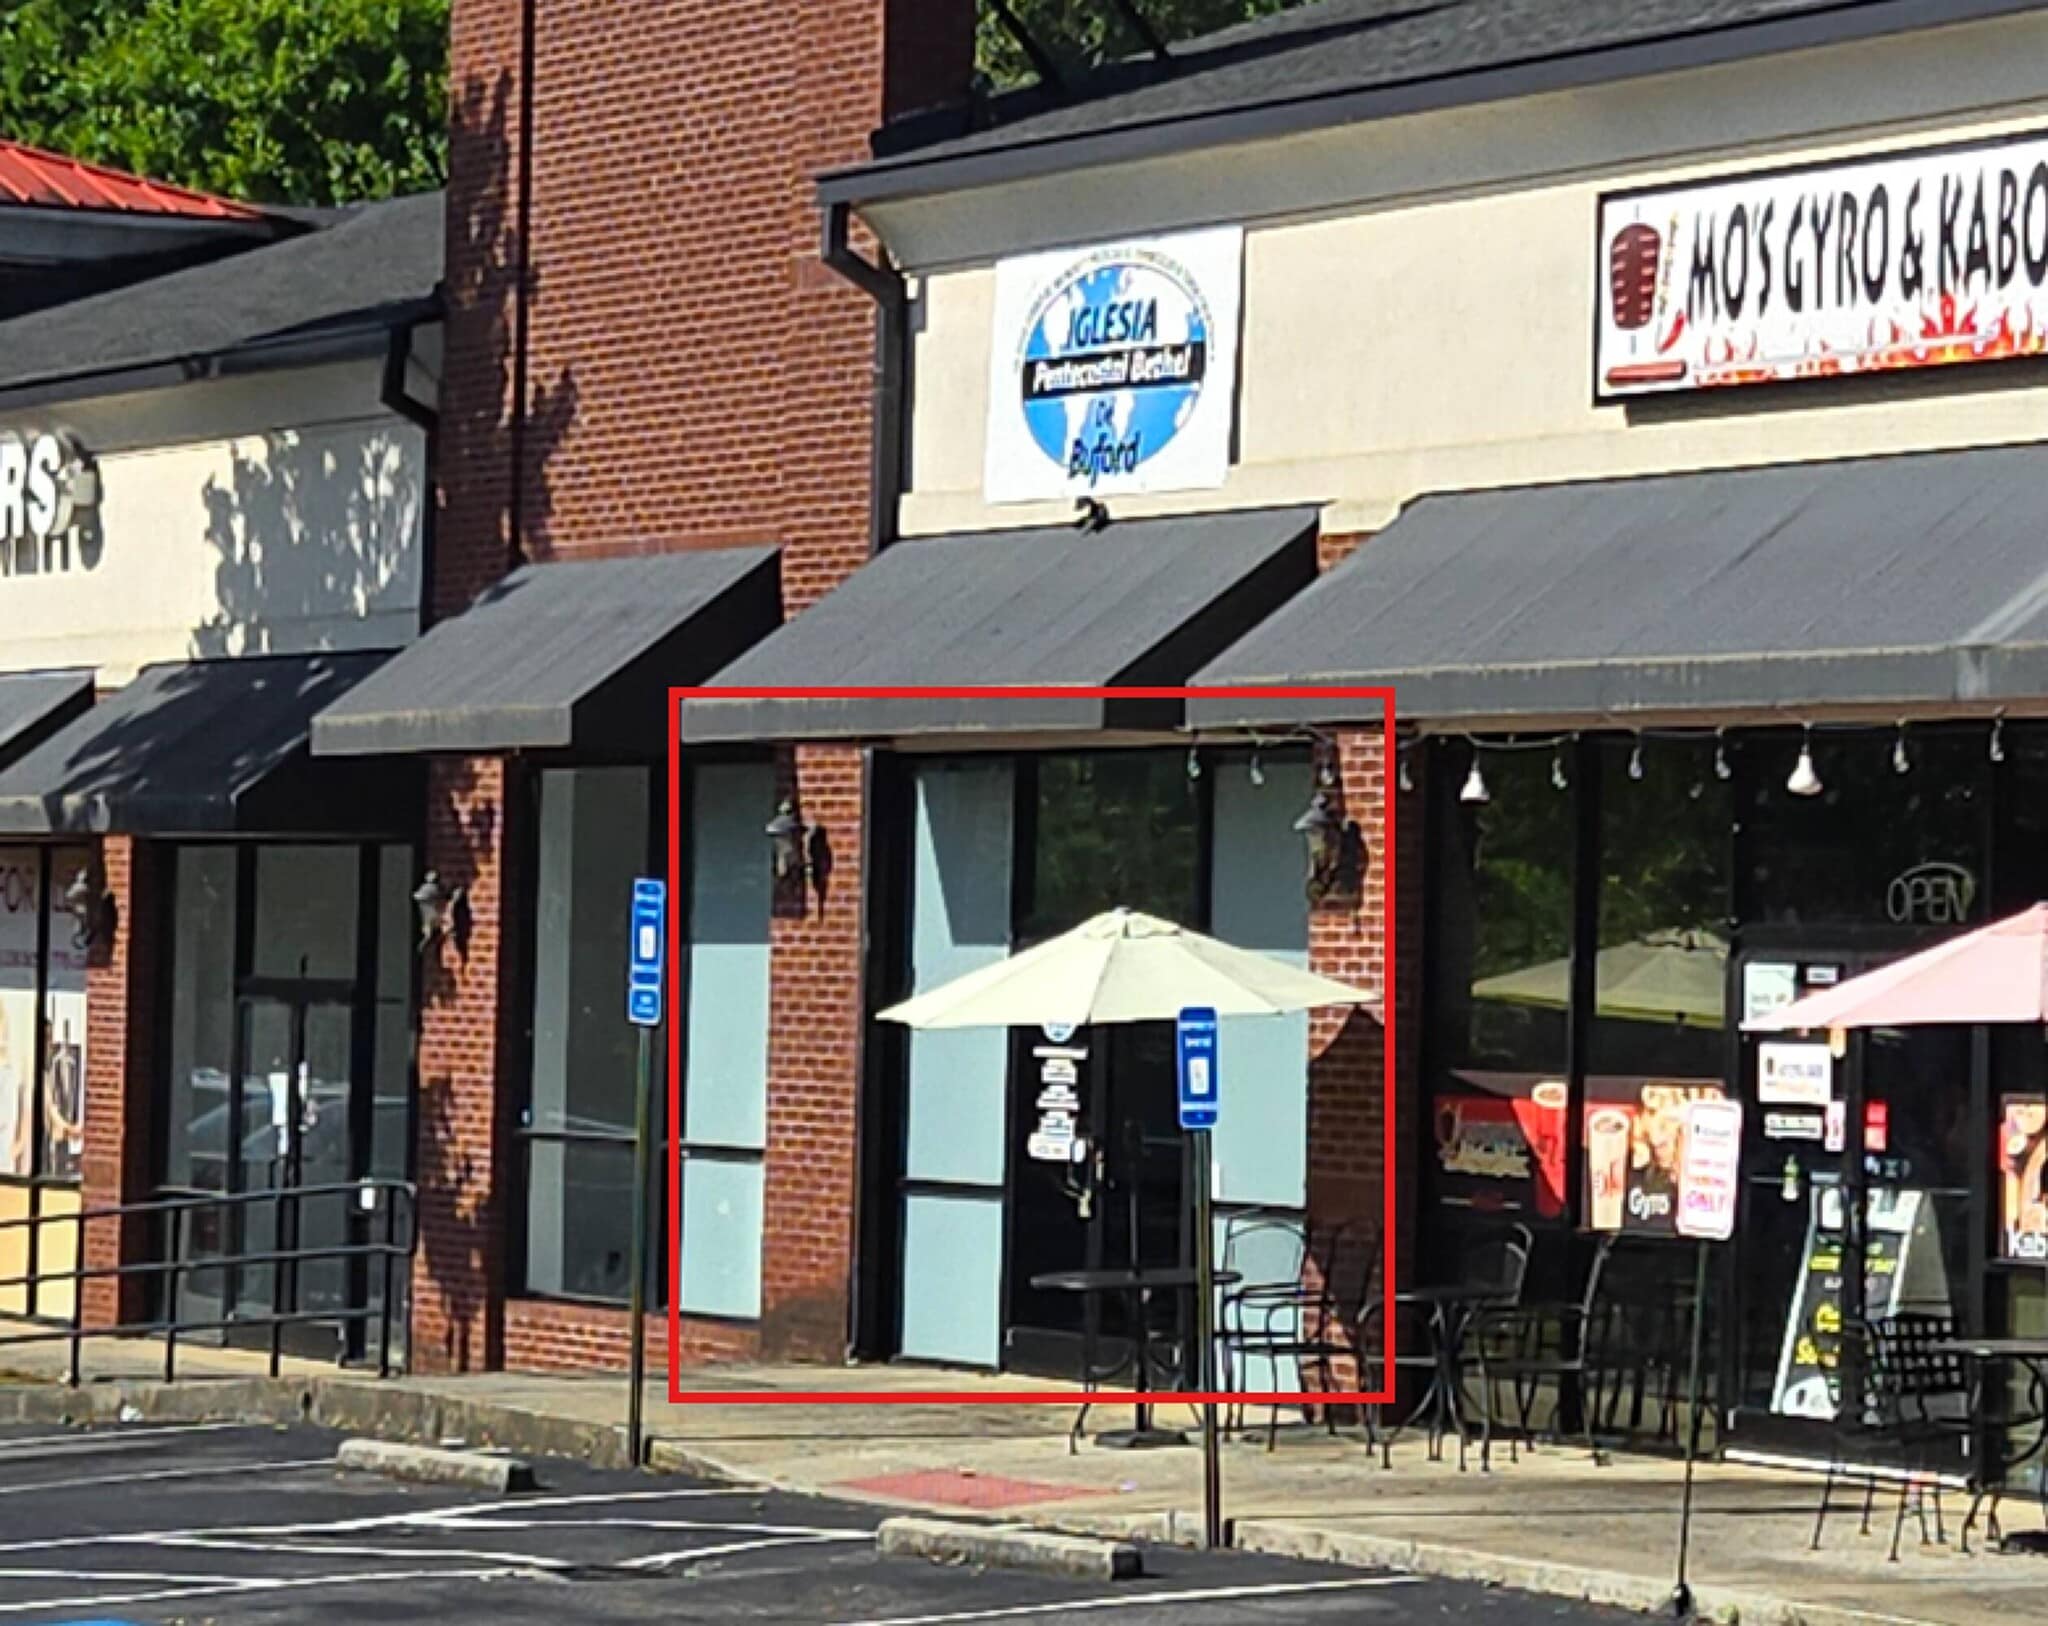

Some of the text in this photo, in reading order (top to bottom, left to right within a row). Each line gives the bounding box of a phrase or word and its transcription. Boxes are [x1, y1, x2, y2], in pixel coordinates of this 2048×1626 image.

[1688, 197, 1775, 323] MO'S
[1783, 182, 1890, 313] GYRO
[1900, 176, 1923, 301] &
[1060, 297, 1158, 349] IGLESIA
[1887, 875, 1966, 922] OPEN
